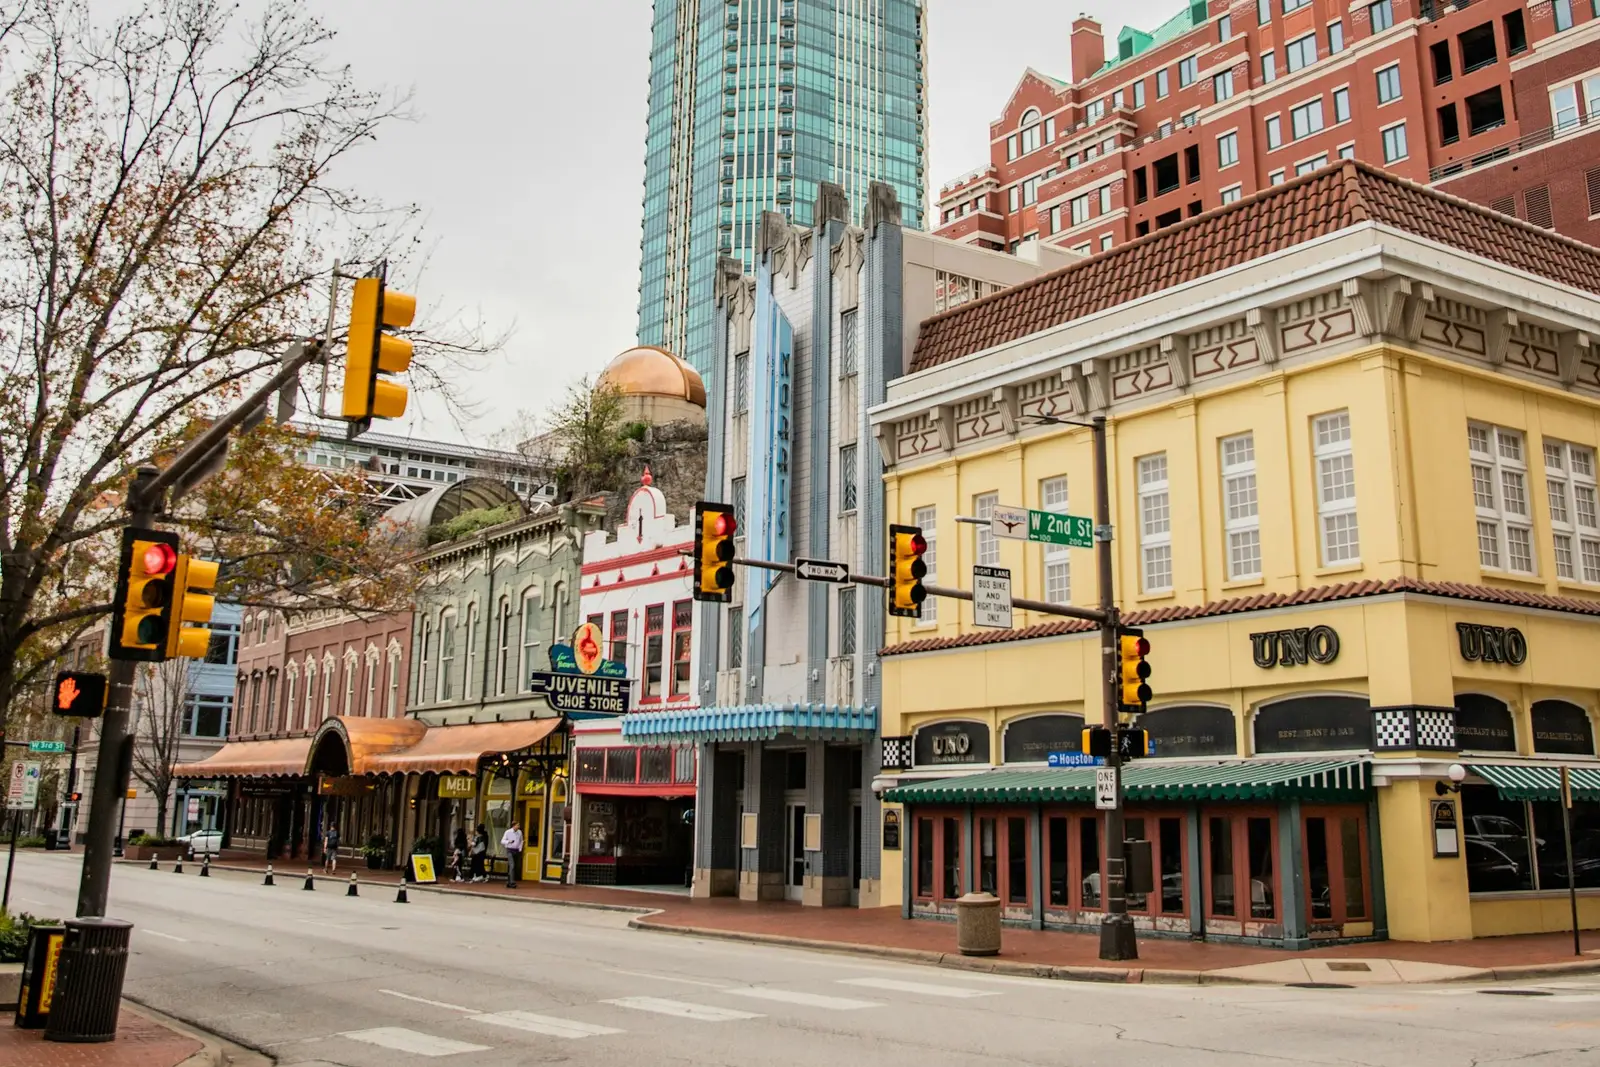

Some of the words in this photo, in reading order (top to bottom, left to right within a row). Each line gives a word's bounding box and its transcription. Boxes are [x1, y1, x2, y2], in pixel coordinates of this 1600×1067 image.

[1031, 512, 1041, 531] W
[1047, 515, 1071, 535] 2nd
[1077, 519, 1092, 538] St
[1039, 534, 1052, 542] 100
[1068, 538, 1082, 546] 200
[808, 566, 821, 574] TWO
[824, 568, 838, 576] WAY
[974, 566, 991, 576] RIGHT
[993, 568, 1010, 578] LANE
[978, 579, 991, 589] BUS
[992, 580, 1006, 591] BIKE
[985, 591, 1001, 599] AND
[976, 602, 992, 612] RIGHT
[993, 602, 1010, 613] TURNS
[987, 613, 1000, 622] ONLY
[1248, 624, 1340, 669] UNO
[1455, 621, 1528, 667] UNO
[544, 675, 620, 697] JUVENILE
[556, 693, 586, 709] SHOE
[589, 696, 624, 711] STORE
[40, 741, 53, 749] 3rd
[931, 733, 970, 755] UNO
[1059, 753, 1094, 766] Houston
[1098, 771, 1114, 783] ONE
[446, 776, 473, 792] MELT
[1098, 782, 1114, 793] WAY
